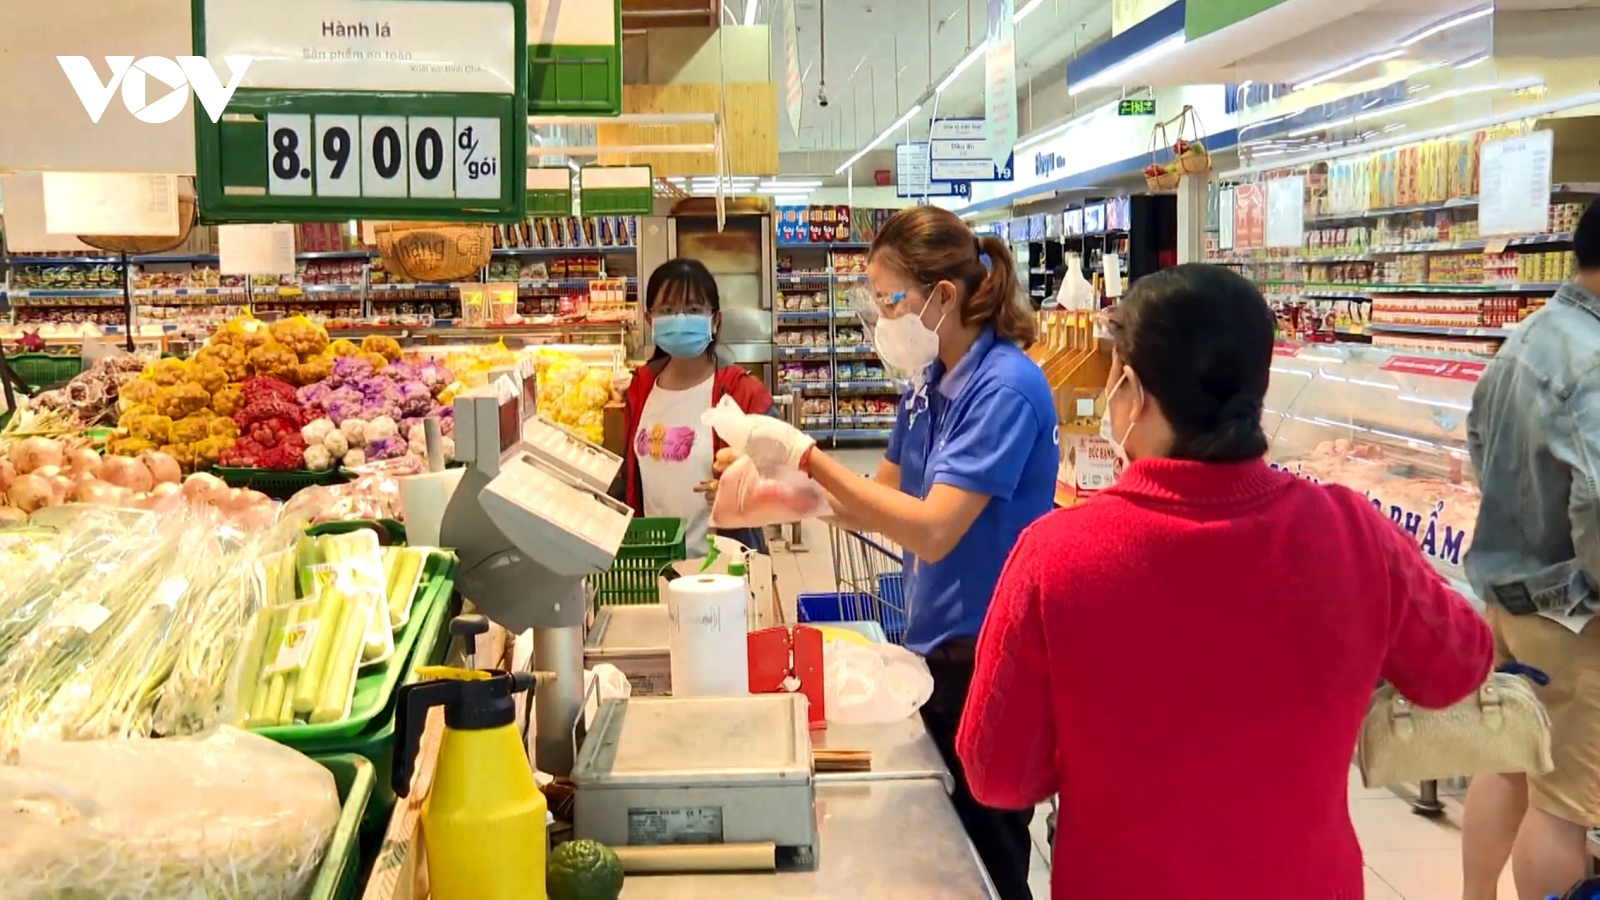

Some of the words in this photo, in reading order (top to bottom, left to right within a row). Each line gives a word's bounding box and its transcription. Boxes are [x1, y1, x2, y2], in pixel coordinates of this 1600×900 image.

[321, 21, 369, 38] Hành
[375, 21, 391, 38] lá
[329, 47, 363, 61] phẩm
[952, 183, 967, 194] 18
